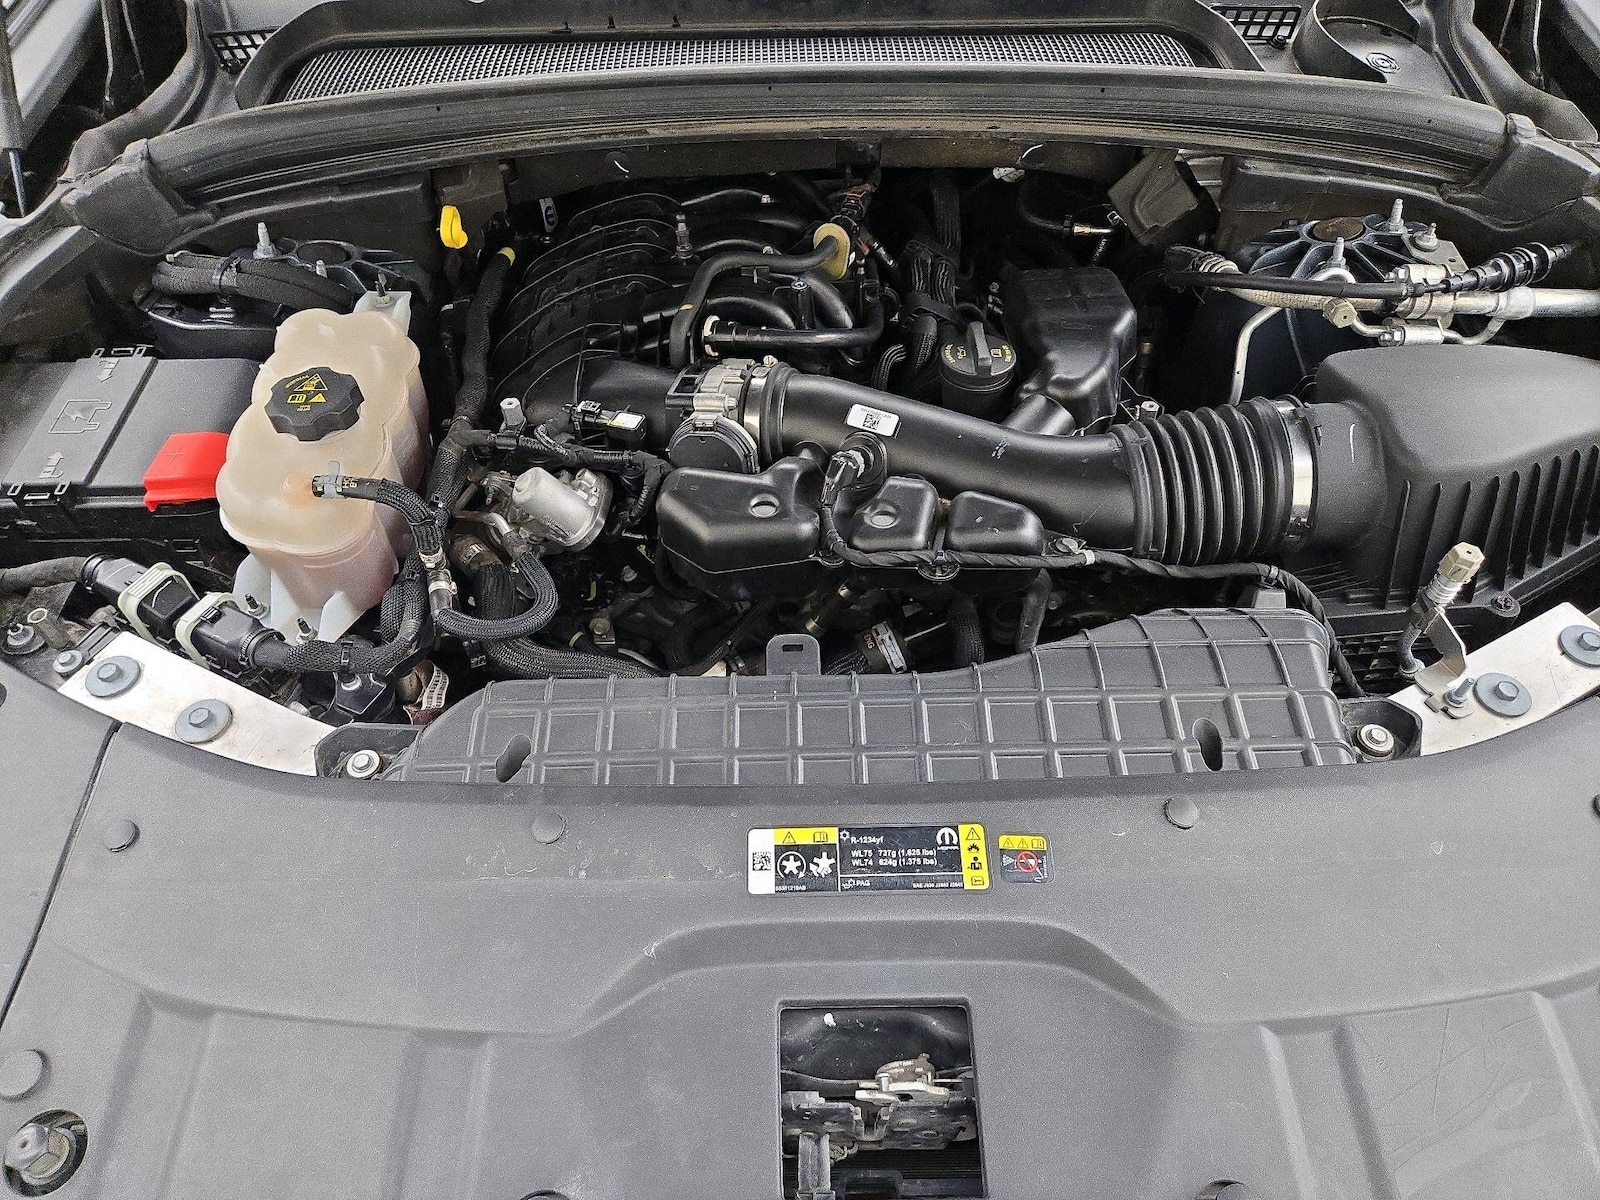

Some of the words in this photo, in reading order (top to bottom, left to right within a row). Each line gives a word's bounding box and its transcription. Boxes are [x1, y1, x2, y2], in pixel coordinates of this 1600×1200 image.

[850, 836, 884, 845] R-1234yf
[851, 849, 873, 858] WL75
[878, 849, 897, 858] 737g
[922, 848, 937, 857] lbs)
[851, 858, 874, 867] WL74
[899, 858, 921, 867] (1.375
[922, 858, 938, 867] lbs)
[855, 879, 871, 887] PAG
